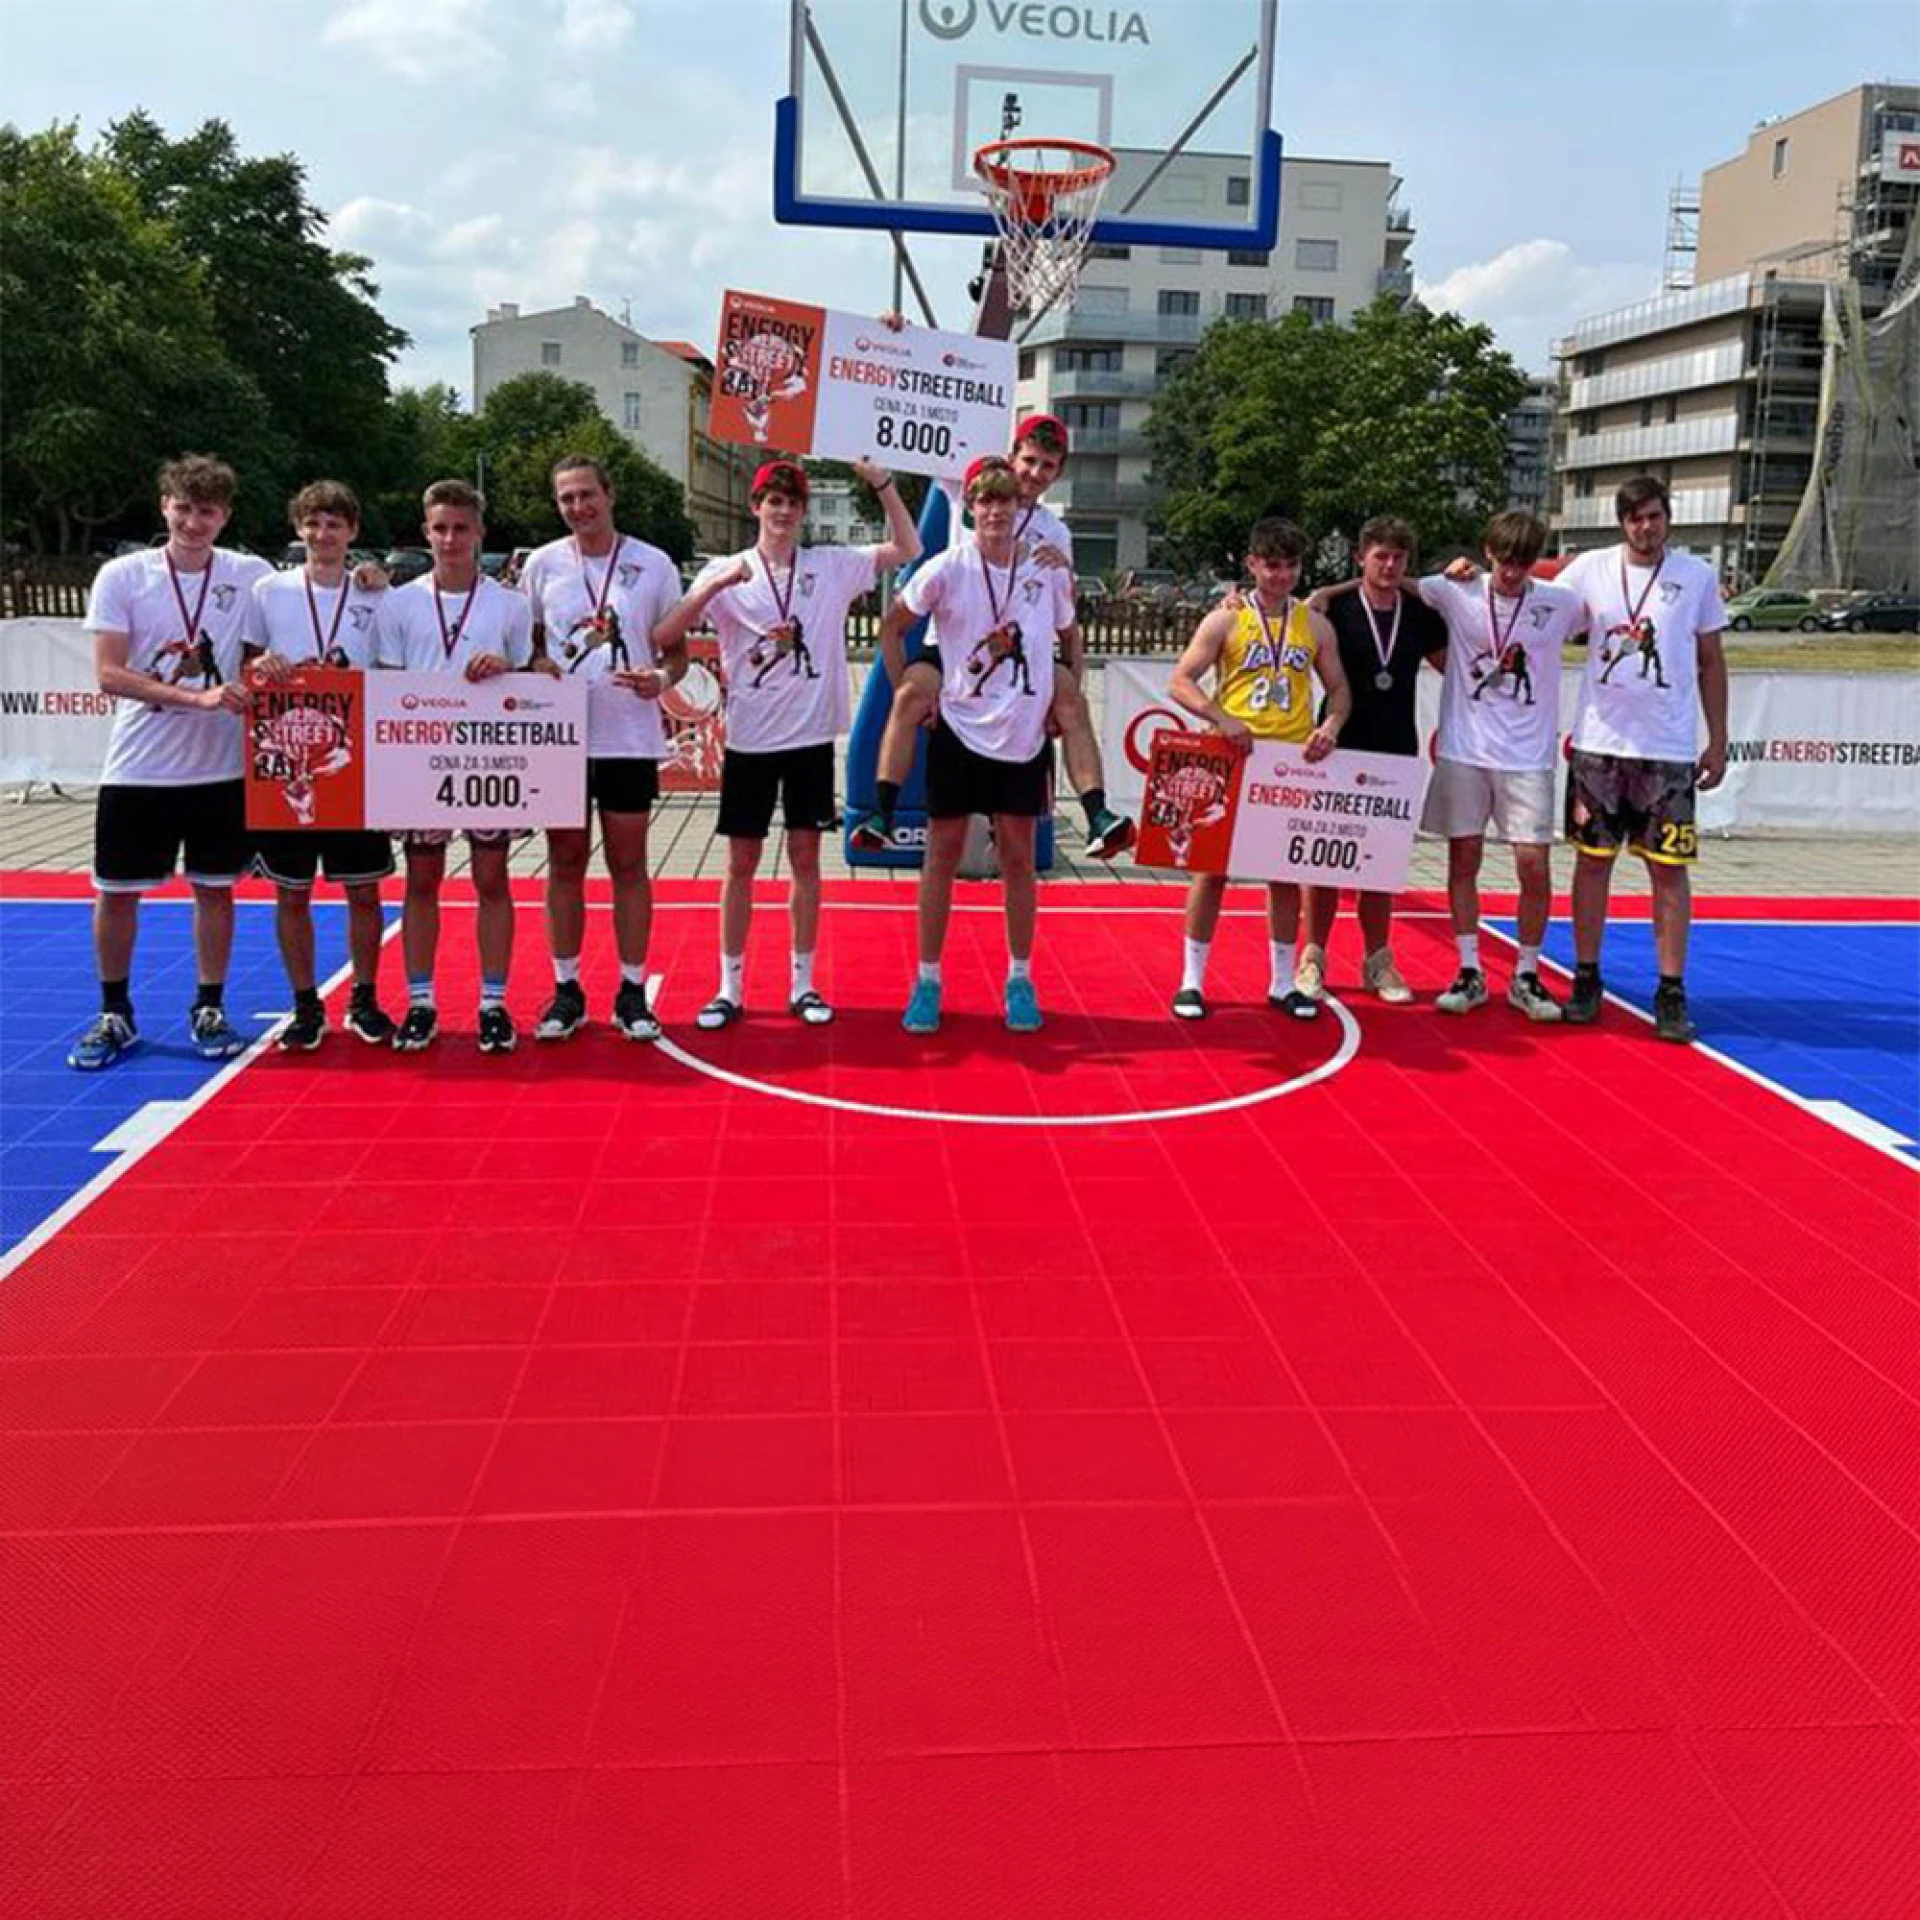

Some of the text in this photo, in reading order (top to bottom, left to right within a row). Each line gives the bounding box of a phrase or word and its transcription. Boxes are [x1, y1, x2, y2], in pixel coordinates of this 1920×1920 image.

[987, 0, 1149, 44] VEOLIA
[829, 356, 1006, 408] ENERGYSTREETBALL
[375, 719, 580, 746] ENERGYSTREETBALL
[1248, 783, 1412, 820] ENERGYSTREETBALL
[1661, 823, 1695, 853] 25
